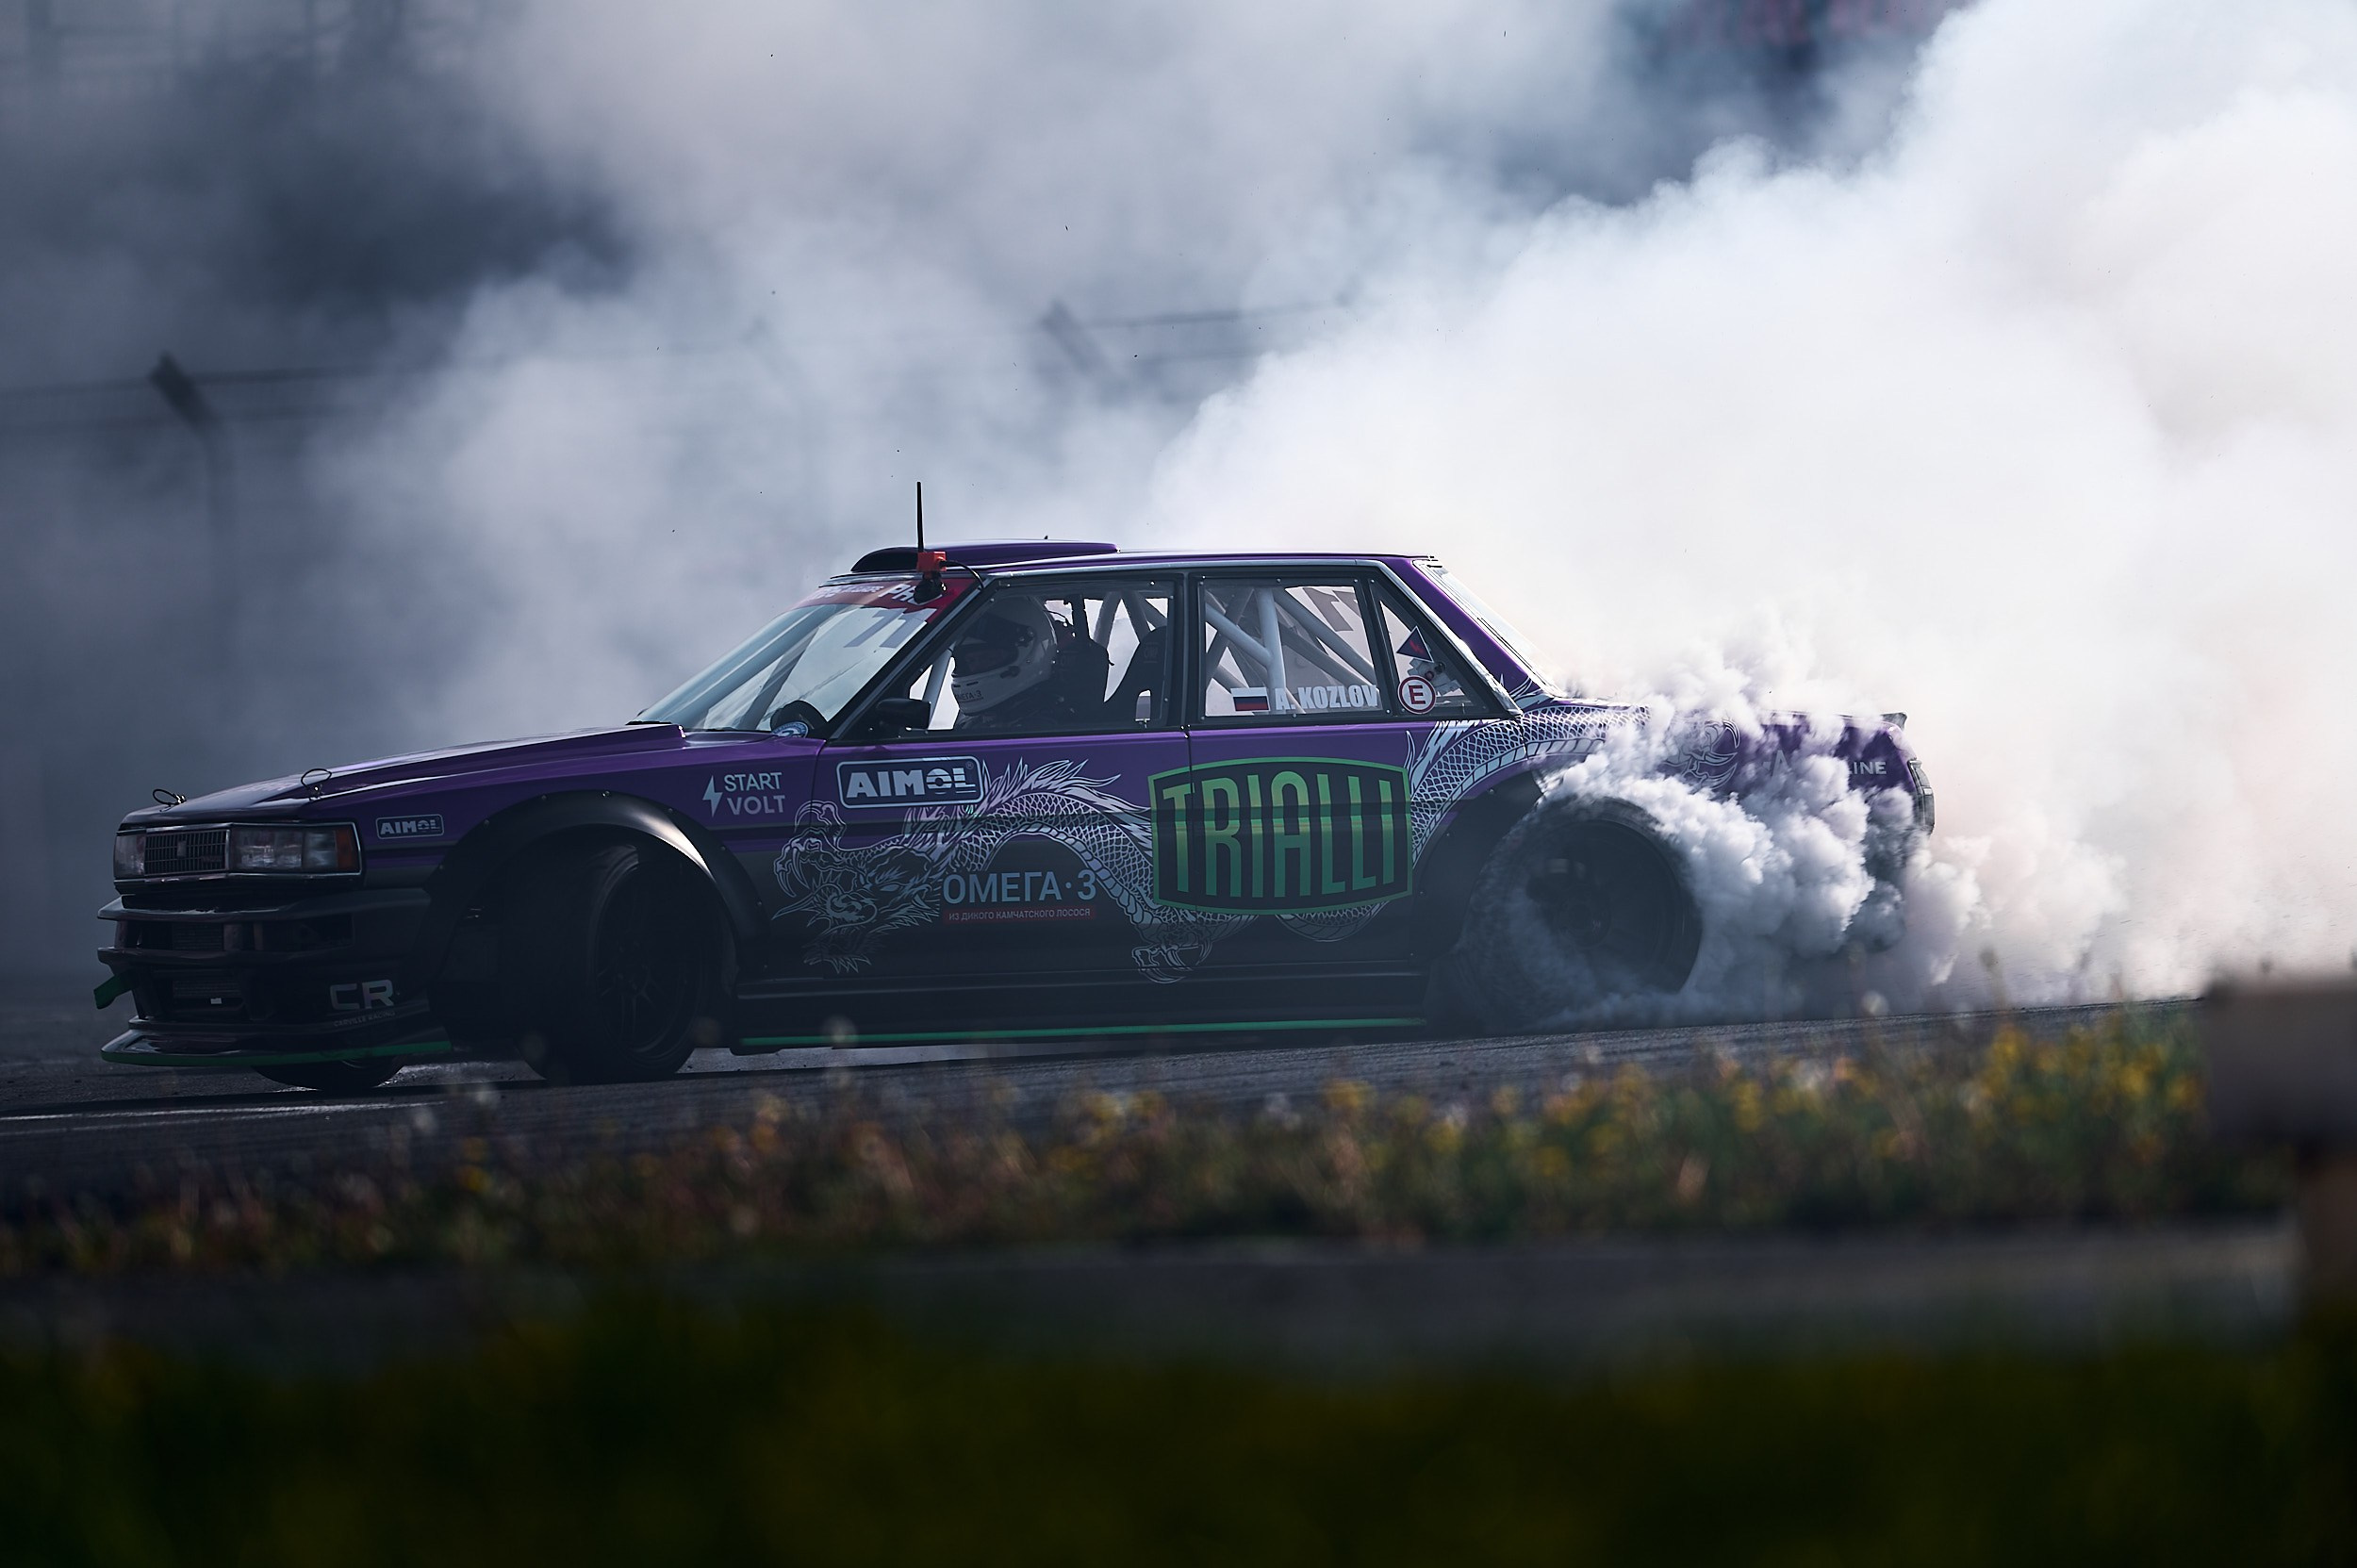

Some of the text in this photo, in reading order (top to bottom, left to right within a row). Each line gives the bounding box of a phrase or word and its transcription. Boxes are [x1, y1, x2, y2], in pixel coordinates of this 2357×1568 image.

[1275, 685, 1378, 711] A. KOZLOV
[1408, 685, 1426, 705] E
[1849, 761, 1887, 775] INE
[724, 771, 783, 792] START
[847, 767, 977, 799] AIMOL
[727, 795, 786, 816] VOLT
[380, 819, 441, 834] AIMOL
[1162, 771, 1394, 899] TRIALLI
[948, 908, 1091, 921] ИЗ ДИКОГО КАМЧАТСКОГО ЛОСОСЯ
[330, 980, 394, 1010] CR
